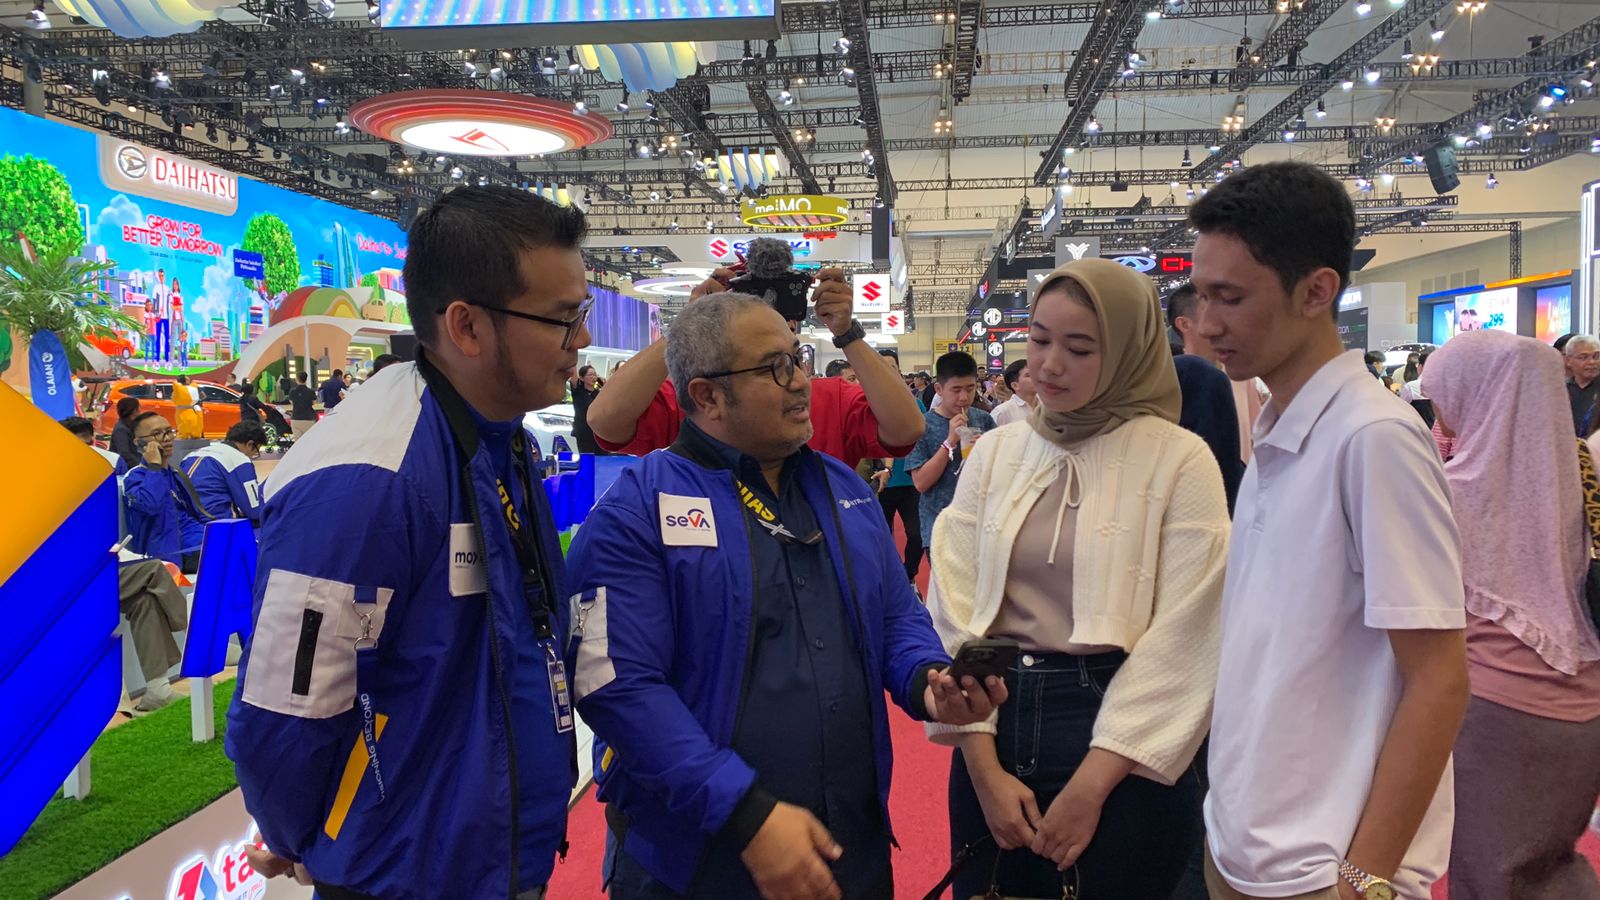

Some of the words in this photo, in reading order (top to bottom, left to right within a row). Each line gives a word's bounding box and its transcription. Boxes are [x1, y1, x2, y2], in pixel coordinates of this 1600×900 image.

[156, 157, 237, 199] DAIHATSU
[123, 225, 163, 247] BETTER
[166, 233, 223, 256] TOMORROW
[147, 215, 180, 234] GROW
[182, 221, 202, 238] FOR
[1488, 312, 1504, 327] 299
[44, 363, 57, 396] OLAIAN
[360, 692, 375, 742] BEYOND
